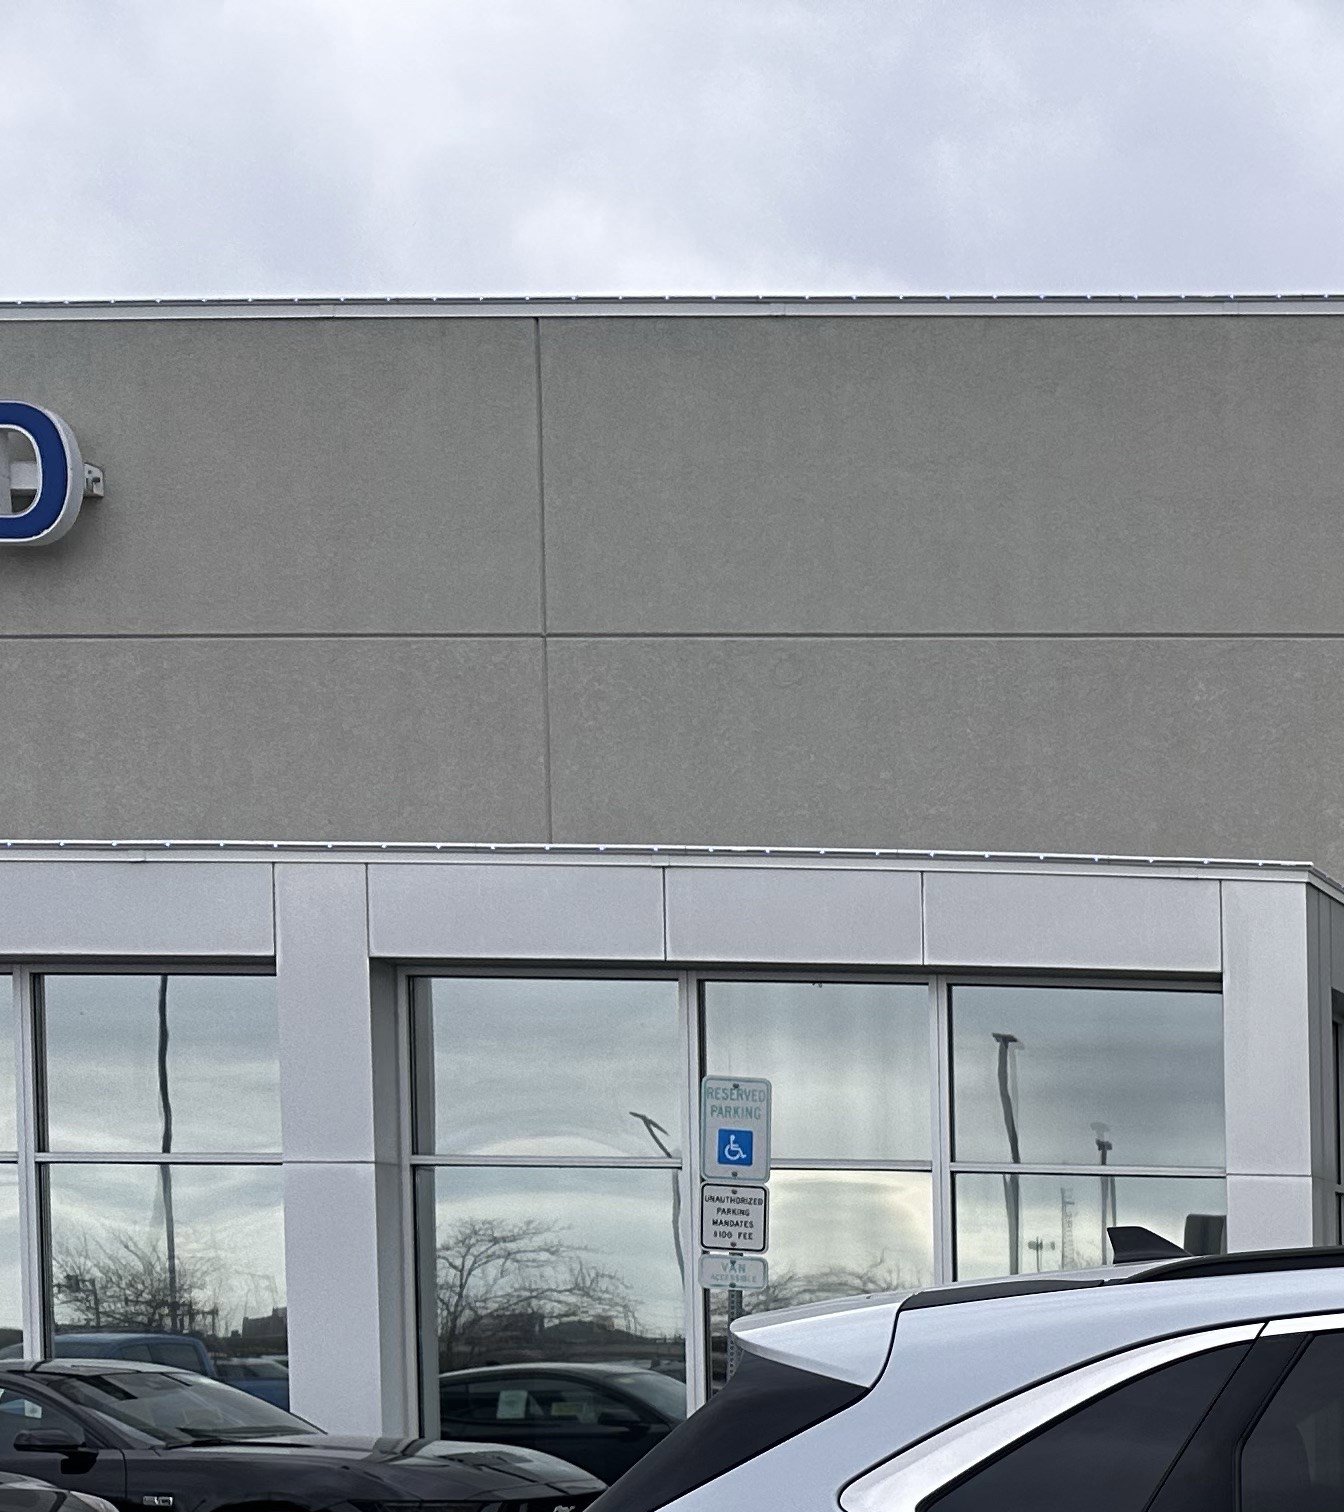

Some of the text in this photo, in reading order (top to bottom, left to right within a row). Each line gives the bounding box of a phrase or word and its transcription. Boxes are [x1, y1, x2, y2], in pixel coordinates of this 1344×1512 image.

[706, 1086, 765, 1102] RESERVED
[710, 1104, 761, 1120] PARKING
[704, 1195, 764, 1206] UNAUTHORIZED
[716, 1207, 750, 1217] PARKING
[712, 1219, 754, 1229] MANDATES
[737, 1231, 753, 1240] FEE
[720, 1261, 747, 1274] VAN
